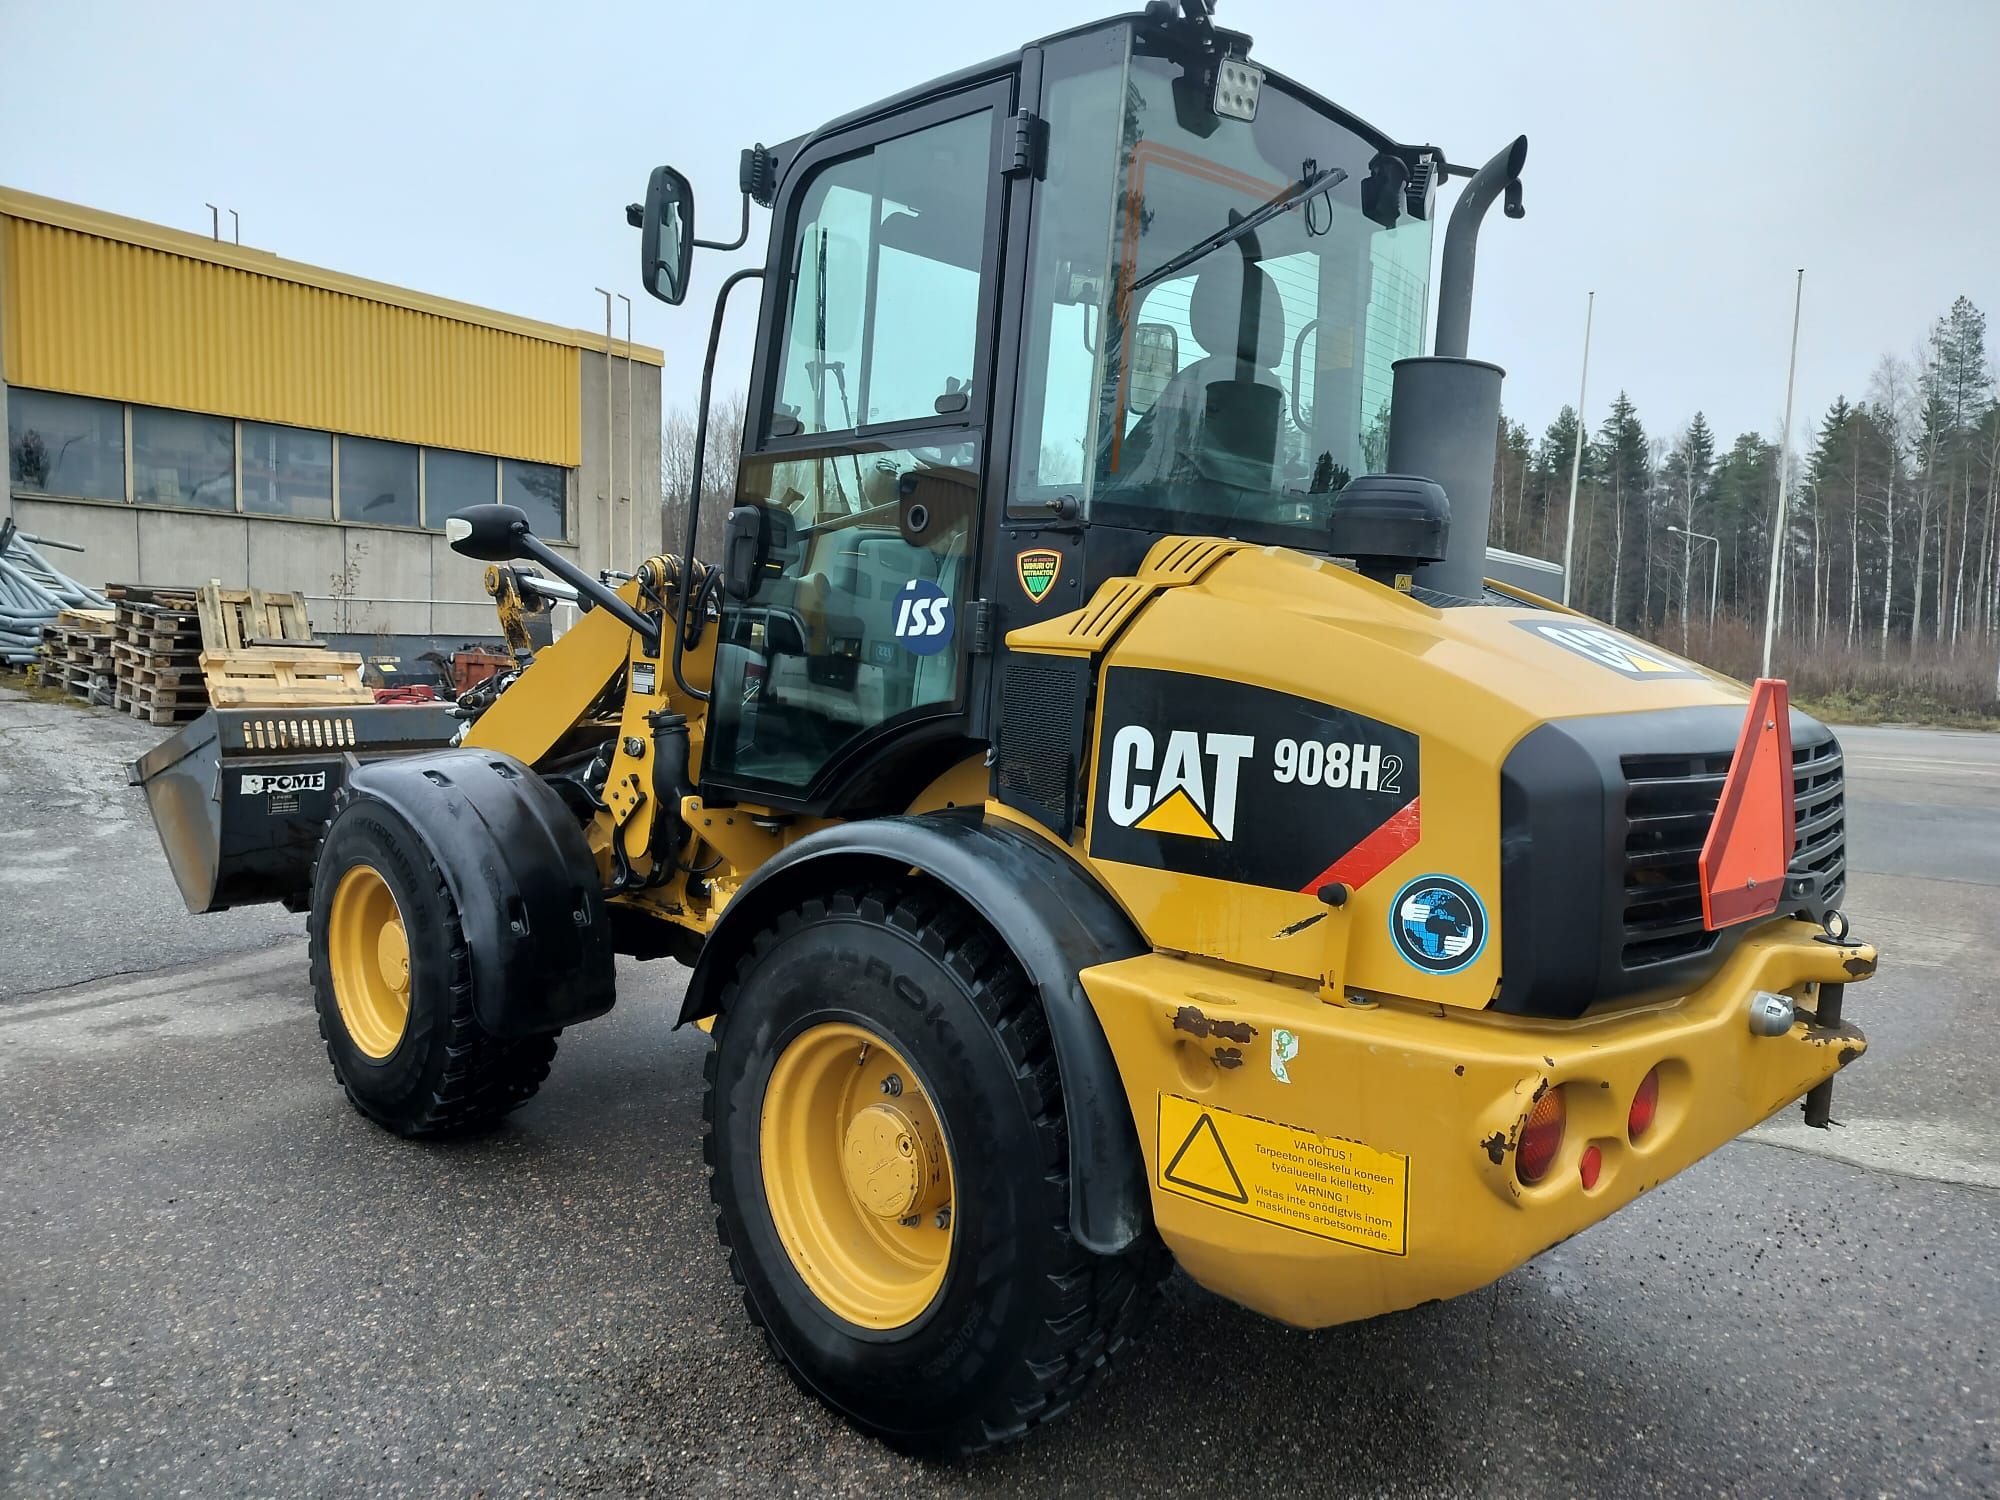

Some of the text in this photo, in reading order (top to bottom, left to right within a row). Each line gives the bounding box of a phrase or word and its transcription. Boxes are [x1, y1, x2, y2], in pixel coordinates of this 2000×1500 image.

[1537, 626, 1687, 673] CAT
[1107, 725, 1405, 842] CAT 908H2
[1254, 1143, 1394, 1185] Tarpeeton oleskelu koneen
[1293, 1139, 1346, 1161] VAROITUS
[1254, 1184, 1393, 1229] Vistas inte onödigtvis inom
[1294, 1182, 1343, 1202] VARNING
[1330, 1175, 1375, 1196] kielletty.
[1255, 1199, 1391, 1242] maskinens arbetsområde.
